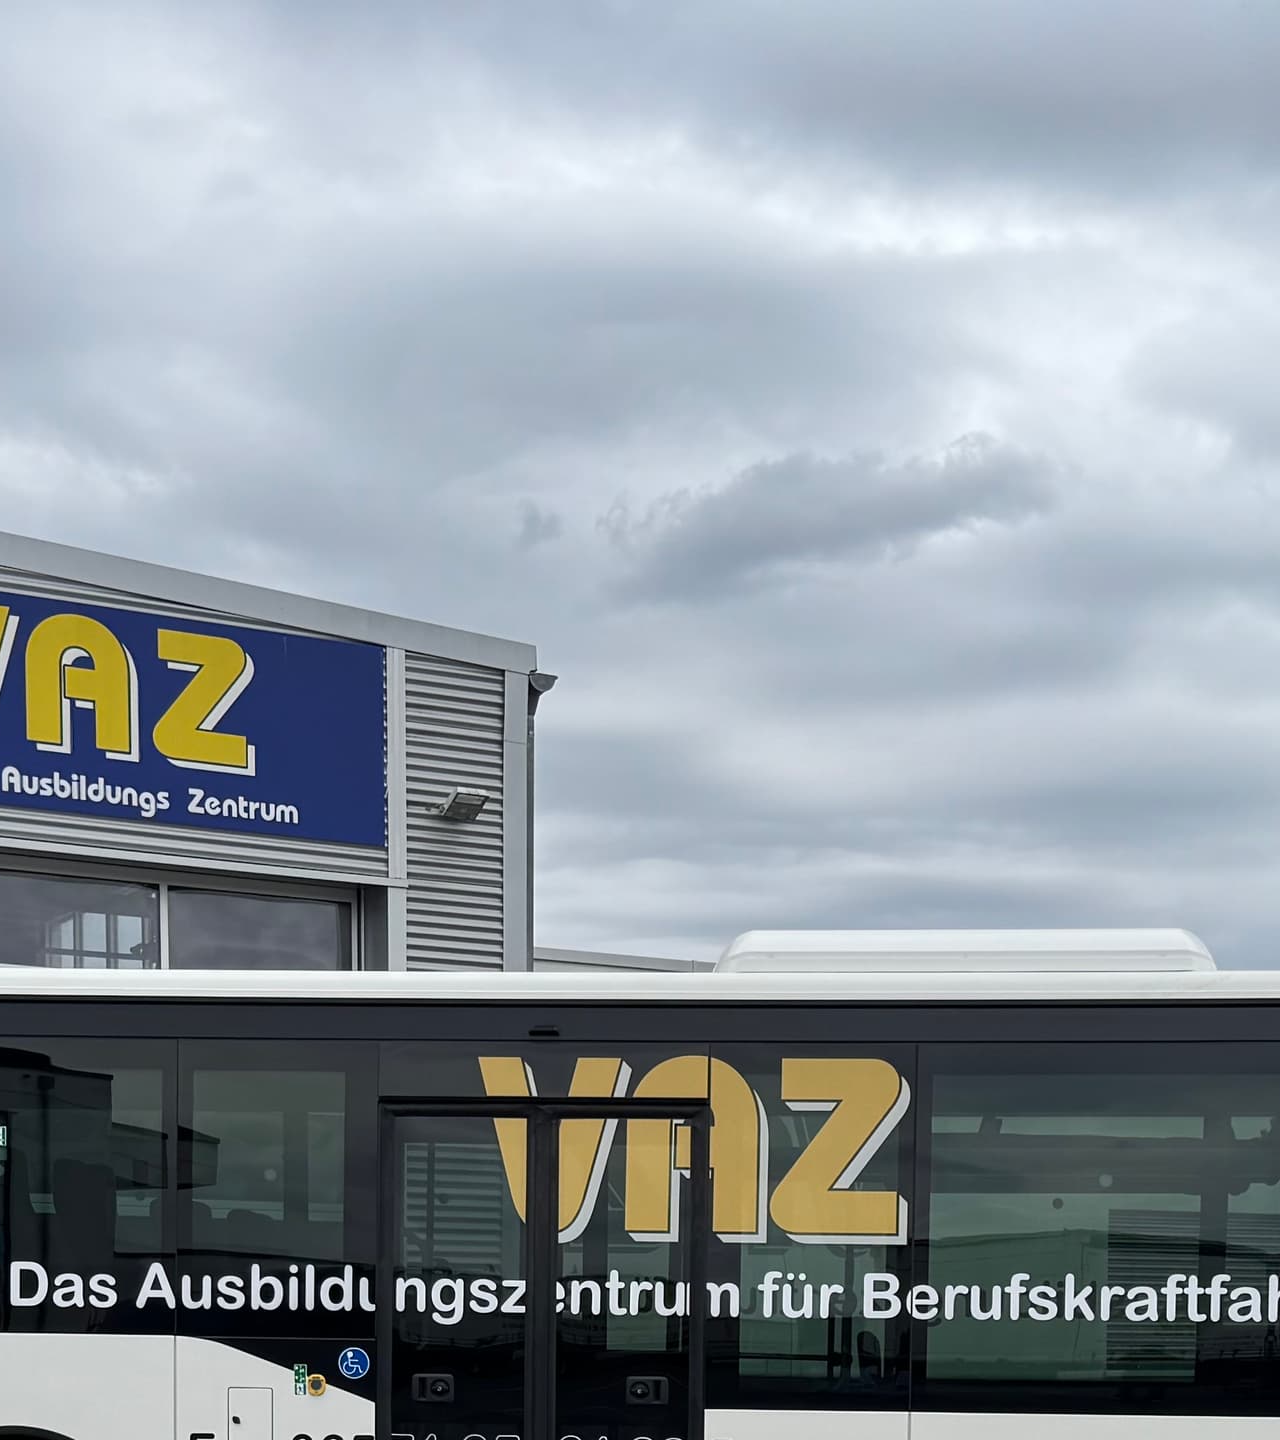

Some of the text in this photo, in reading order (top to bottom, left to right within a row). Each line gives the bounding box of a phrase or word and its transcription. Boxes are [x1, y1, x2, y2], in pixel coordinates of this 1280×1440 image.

[1, 765, 170, 818] Ausbildungs
[187, 787, 300, 825] Zentrum
[478, 1055, 911, 1246] VAZ
[8, 1261, 119, 1309] Das
[757, 1271, 845, 1319] für
